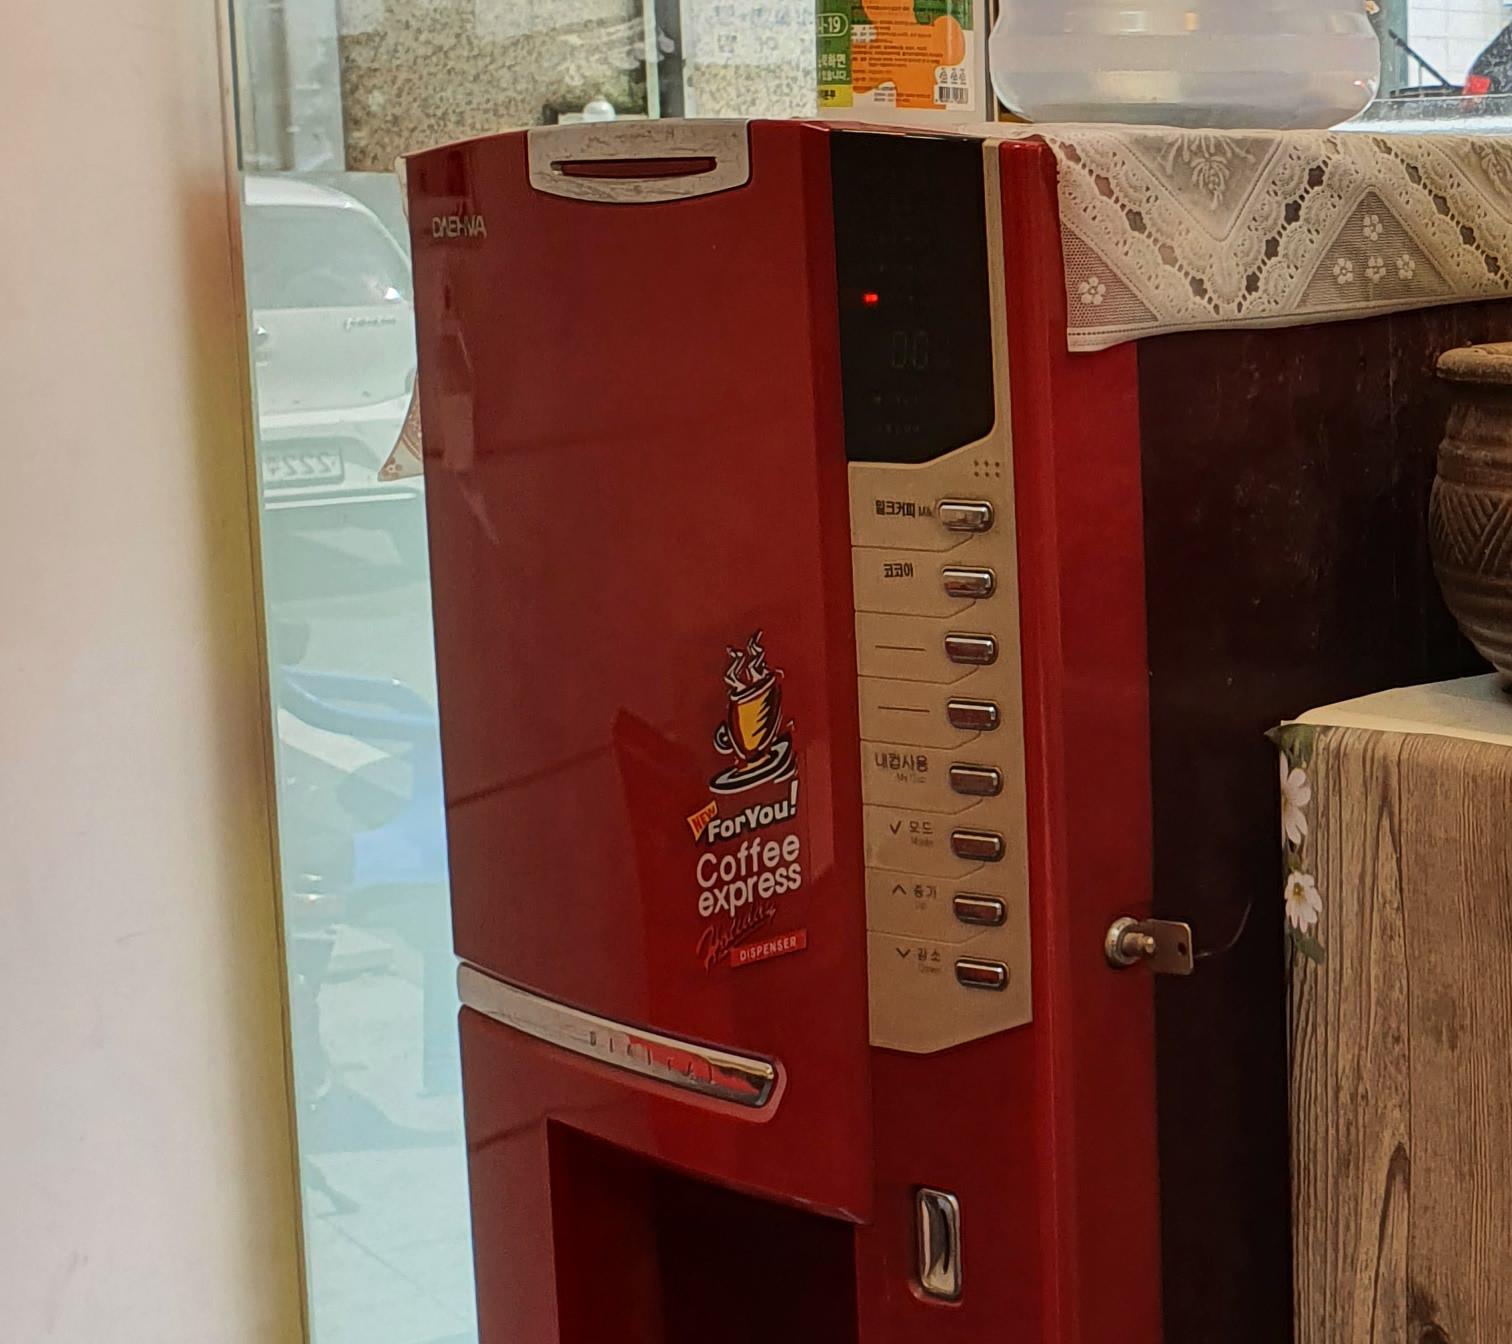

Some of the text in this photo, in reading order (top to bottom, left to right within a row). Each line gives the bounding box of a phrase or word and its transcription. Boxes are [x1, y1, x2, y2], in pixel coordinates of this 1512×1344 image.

[696, 834, 801, 889] Coffee
[697, 863, 802, 919] express
[739, 937, 798, 963] DISPENSER
